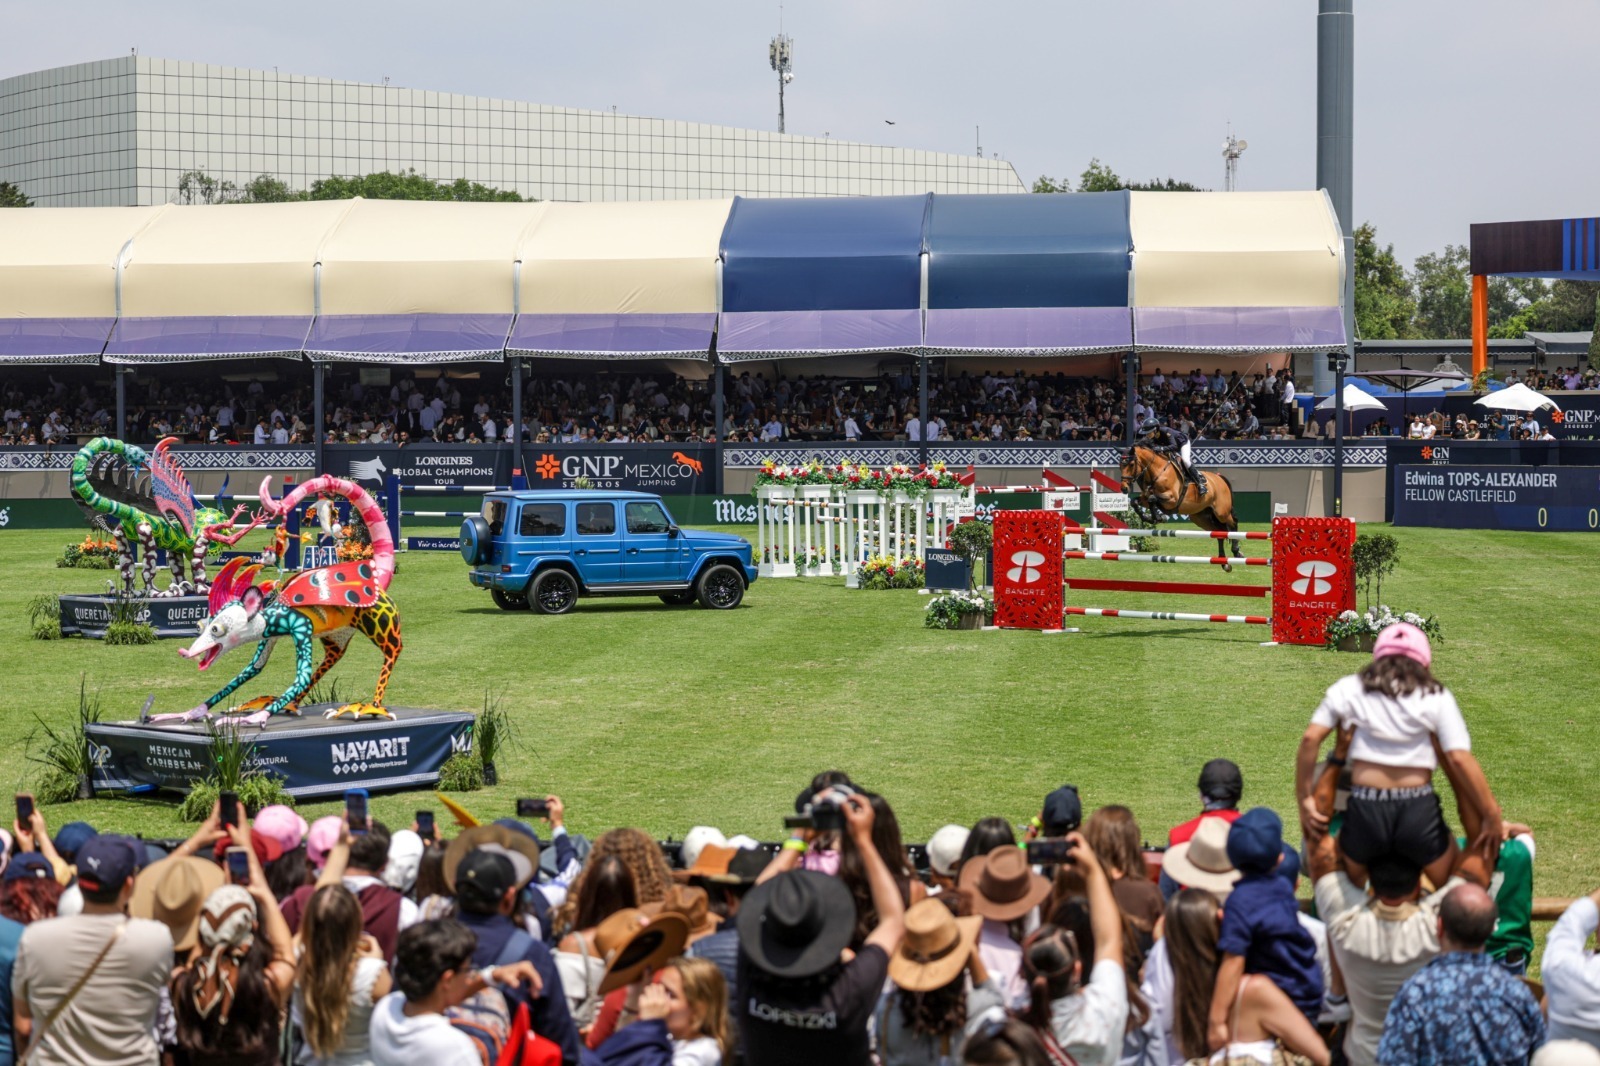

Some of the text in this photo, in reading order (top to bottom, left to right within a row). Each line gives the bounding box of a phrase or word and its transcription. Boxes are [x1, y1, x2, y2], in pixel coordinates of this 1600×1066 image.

[1564, 410, 1594, 423] GNP
[1432, 447, 1449, 458] GN
[415, 456, 473, 465] LONGINES
[562, 456, 623, 477] GNP
[435, 468, 493, 476] CHAMPIONS
[625, 464, 693, 478] MEXICO
[637, 479, 676, 487] JUMPING
[1405, 471, 1557, 487] Edwina TOPS-ALEXANDER
[1405, 488, 1517, 503] FELLOW CASTLEFIELD
[1538, 507, 1547, 527] 0
[1005, 587, 1045, 596] BANORTE
[1289, 600, 1337, 609] BANORTE
[74, 607, 113, 620] QUERÉTAR
[168, 604, 208, 620] QUERÉT
[149, 745, 192, 759] MEXICAN
[331, 736, 410, 763] NAYARIT
[146, 756, 201, 771] CARIBBEAN
[252, 756, 288, 766] CULTURAL
